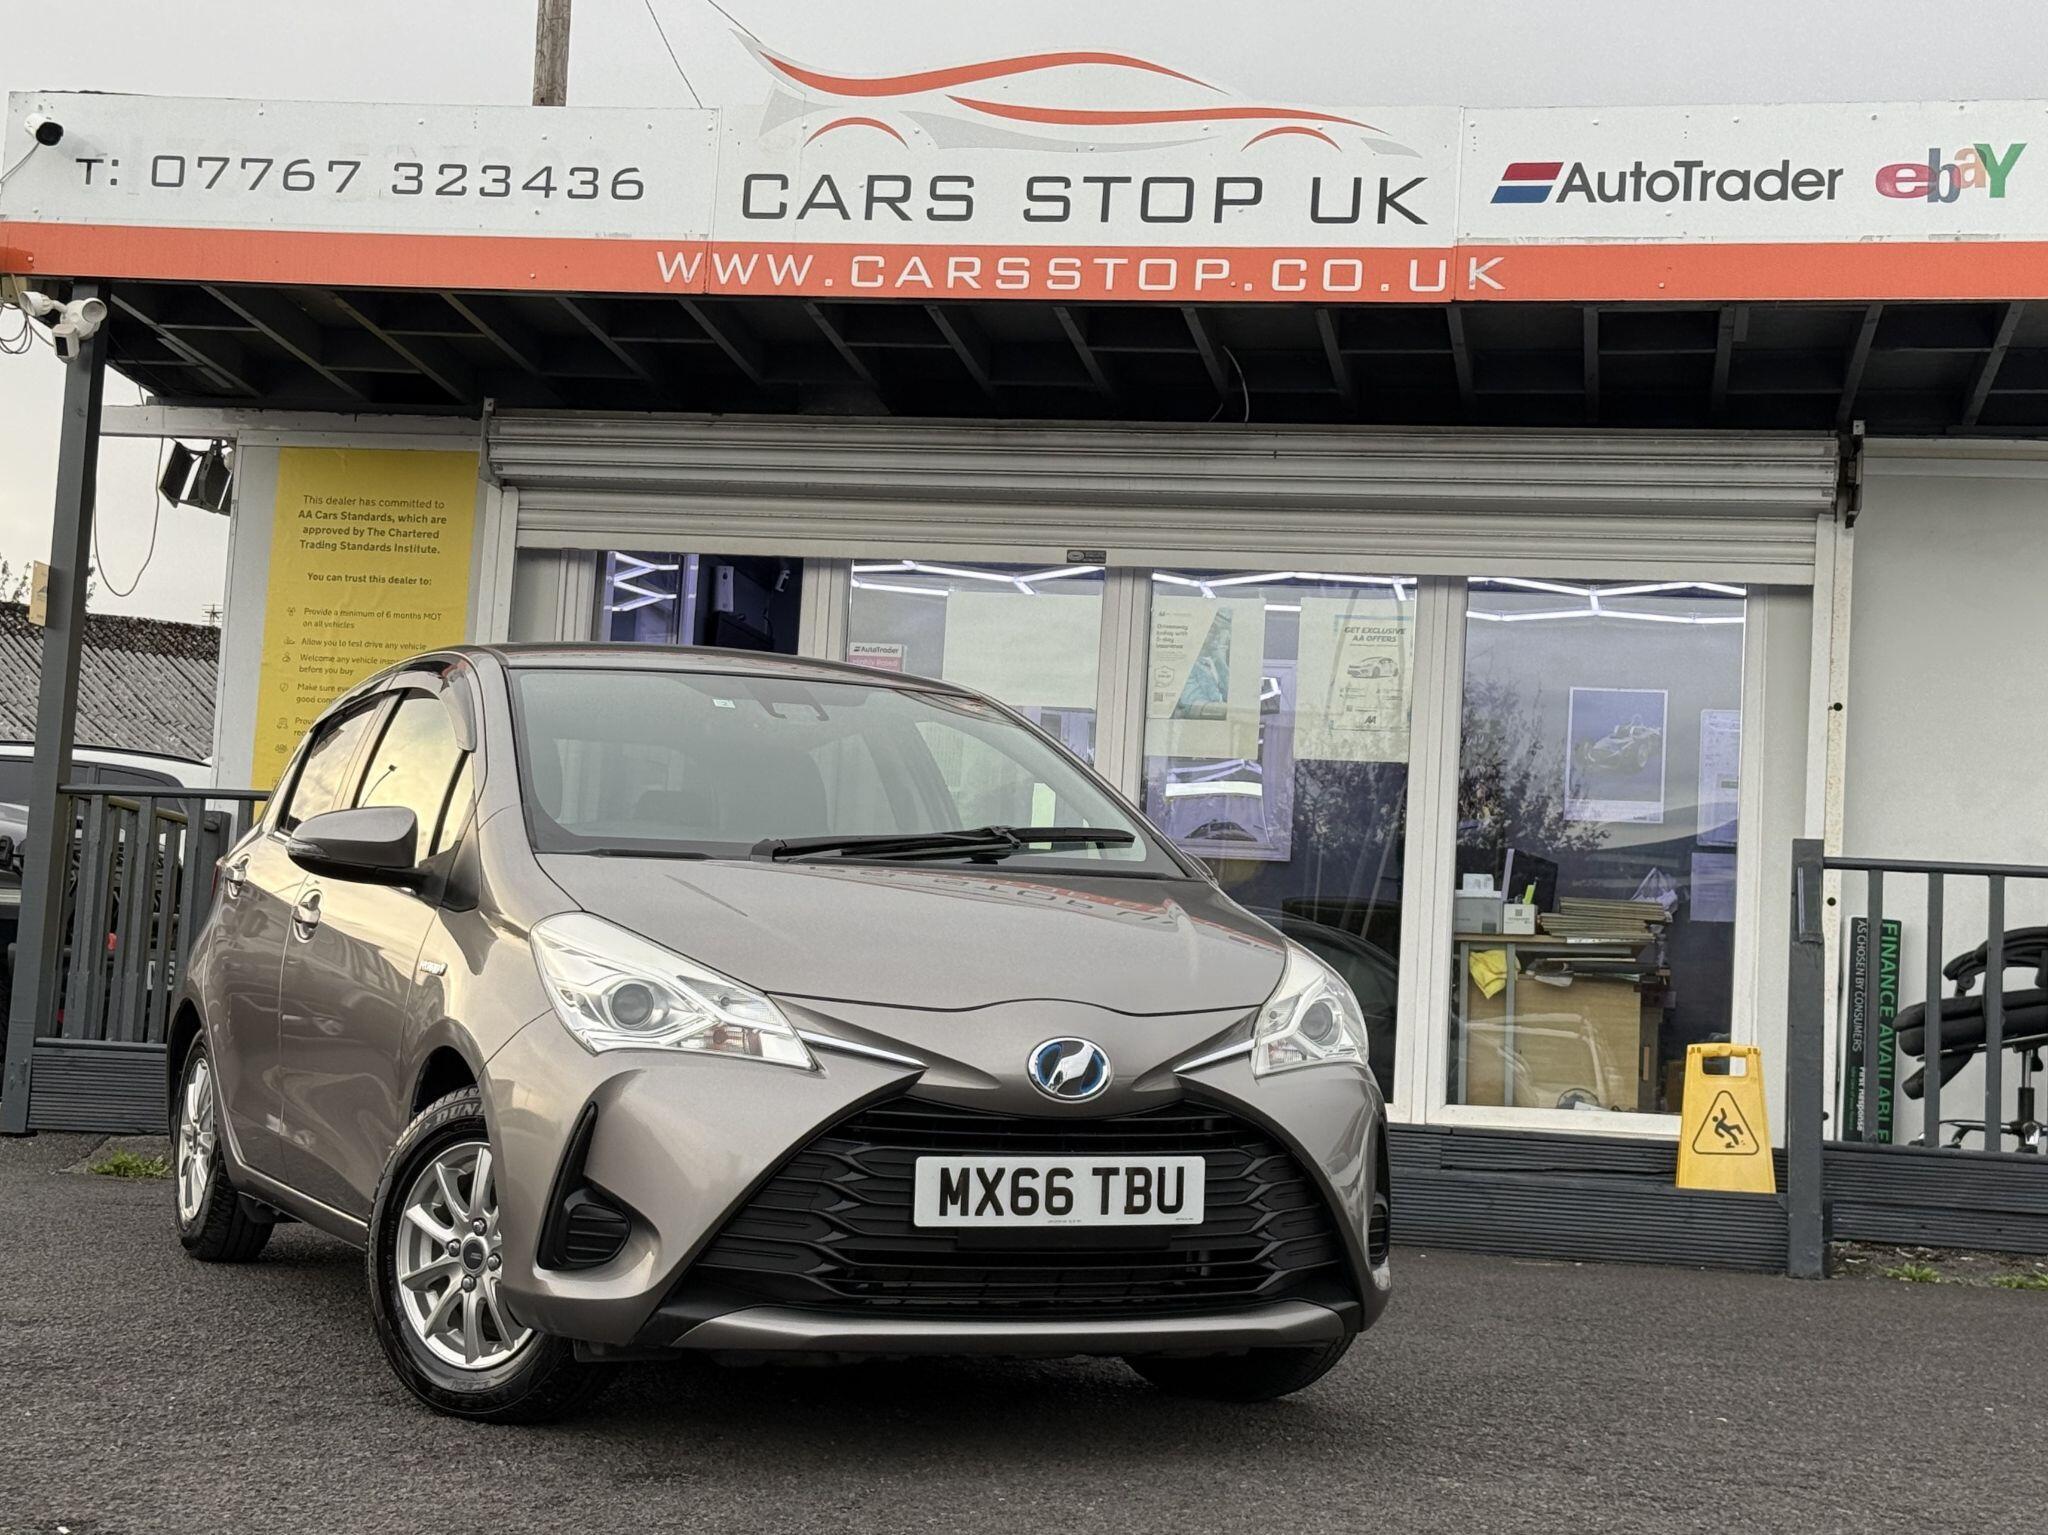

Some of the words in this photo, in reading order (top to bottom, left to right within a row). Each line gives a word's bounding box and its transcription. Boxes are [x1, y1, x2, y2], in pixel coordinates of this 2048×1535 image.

[75, 157, 119, 187] T:
[150, 155, 362, 194] 07767
[391, 162, 646, 201] 323436
[1555, 159, 1844, 203] AutoTrader
[740, 172, 975, 221] CARS
[1023, 175, 1263, 223] STOP
[1308, 176, 1430, 225] UK
[656, 251, 1506, 293] WWW.CARSSTOP.CO.UK
[303, 494, 323, 505] This
[325, 495, 356, 506] dealer
[358, 496, 376, 507] has
[378, 498, 432, 509] committed
[434, 499, 445, 510] to
[298, 509, 313, 519] AA
[314, 510, 338, 520] Cars
[340, 511, 396, 523] Standards,
[397, 513, 428, 524] which
[430, 516, 447, 525] are
[302, 526, 350, 537] approved
[352, 526, 365, 538] by
[367, 527, 386, 537] The
[388, 528, 440, 539] Chartered
[300, 539, 337, 552] Trading
[340, 541, 392, 552] Standards
[394, 543, 441, 554] Institute.
[307, 572, 324, 582] You
[326, 574, 343, 582] can
[344, 574, 367, 583] trust
[369, 575, 386, 584] this
[388, 575, 417, 585] dealer
[419, 576, 432, 586] to:
[304, 607, 333, 616] Provide
[340, 609, 375, 618] minimum
[376, 609, 385, 618] of
[393, 610, 422, 620] months
[423, 612, 442, 621] MOT
[302, 620, 312, 628] on
[1344, 626, 1361, 634] GET
[1361, 627, 1407, 635] EXCLUSIVE
[301, 637, 321, 646] Allow
[323, 639, 338, 648] you
[338, 639, 347, 647] to
[364, 640, 384, 649] drive
[384, 641, 399, 650] any
[1365, 635, 1397, 643] OFFERS
[300, 654, 335, 663] Welcome
[336, 655, 350, 664] any
[351, 655, 378, 664] vehicle
[299, 665, 323, 674] before
[324, 667, 339, 676] you
[340, 667, 354, 676] buy
[296, 683, 318, 691] Make
[296, 696, 316, 704] good
[1856, 919, 1869, 934] AS
[1855, 934, 1868, 976] CHOSEN
[1880, 922, 1898, 1018] FINANCE
[1855, 976, 1866, 990] BY
[1852, 990, 1866, 1052] CONSUMERS
[938, 1166, 1075, 1217] MX66
[1091, 1165, 1186, 1216] TBU
